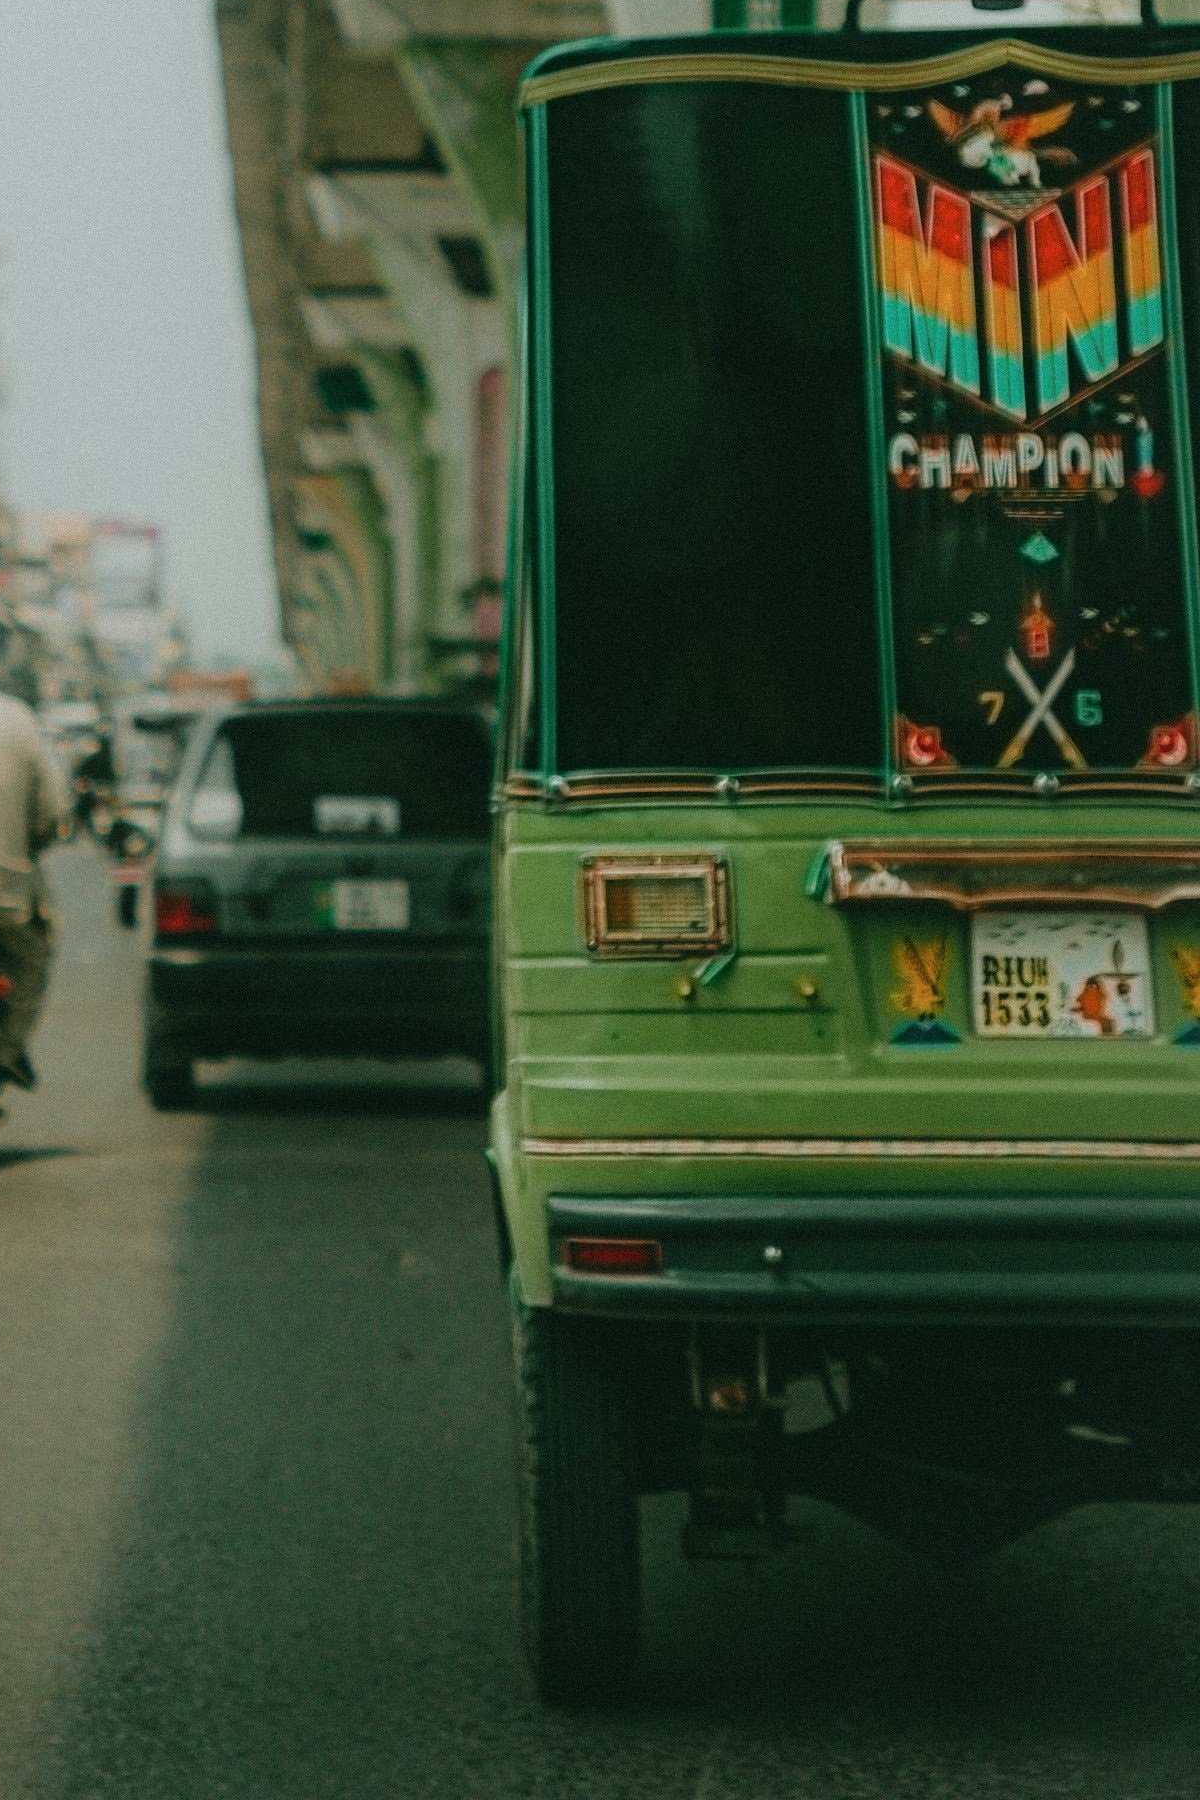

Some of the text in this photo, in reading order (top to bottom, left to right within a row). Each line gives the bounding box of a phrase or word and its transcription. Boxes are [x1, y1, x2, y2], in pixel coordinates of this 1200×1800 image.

[875, 149, 1163, 424] MINI
[890, 431, 1125, 490] CHAMPION
[977, 690, 1006, 726] 7
[982, 990, 1052, 1028] 1533
